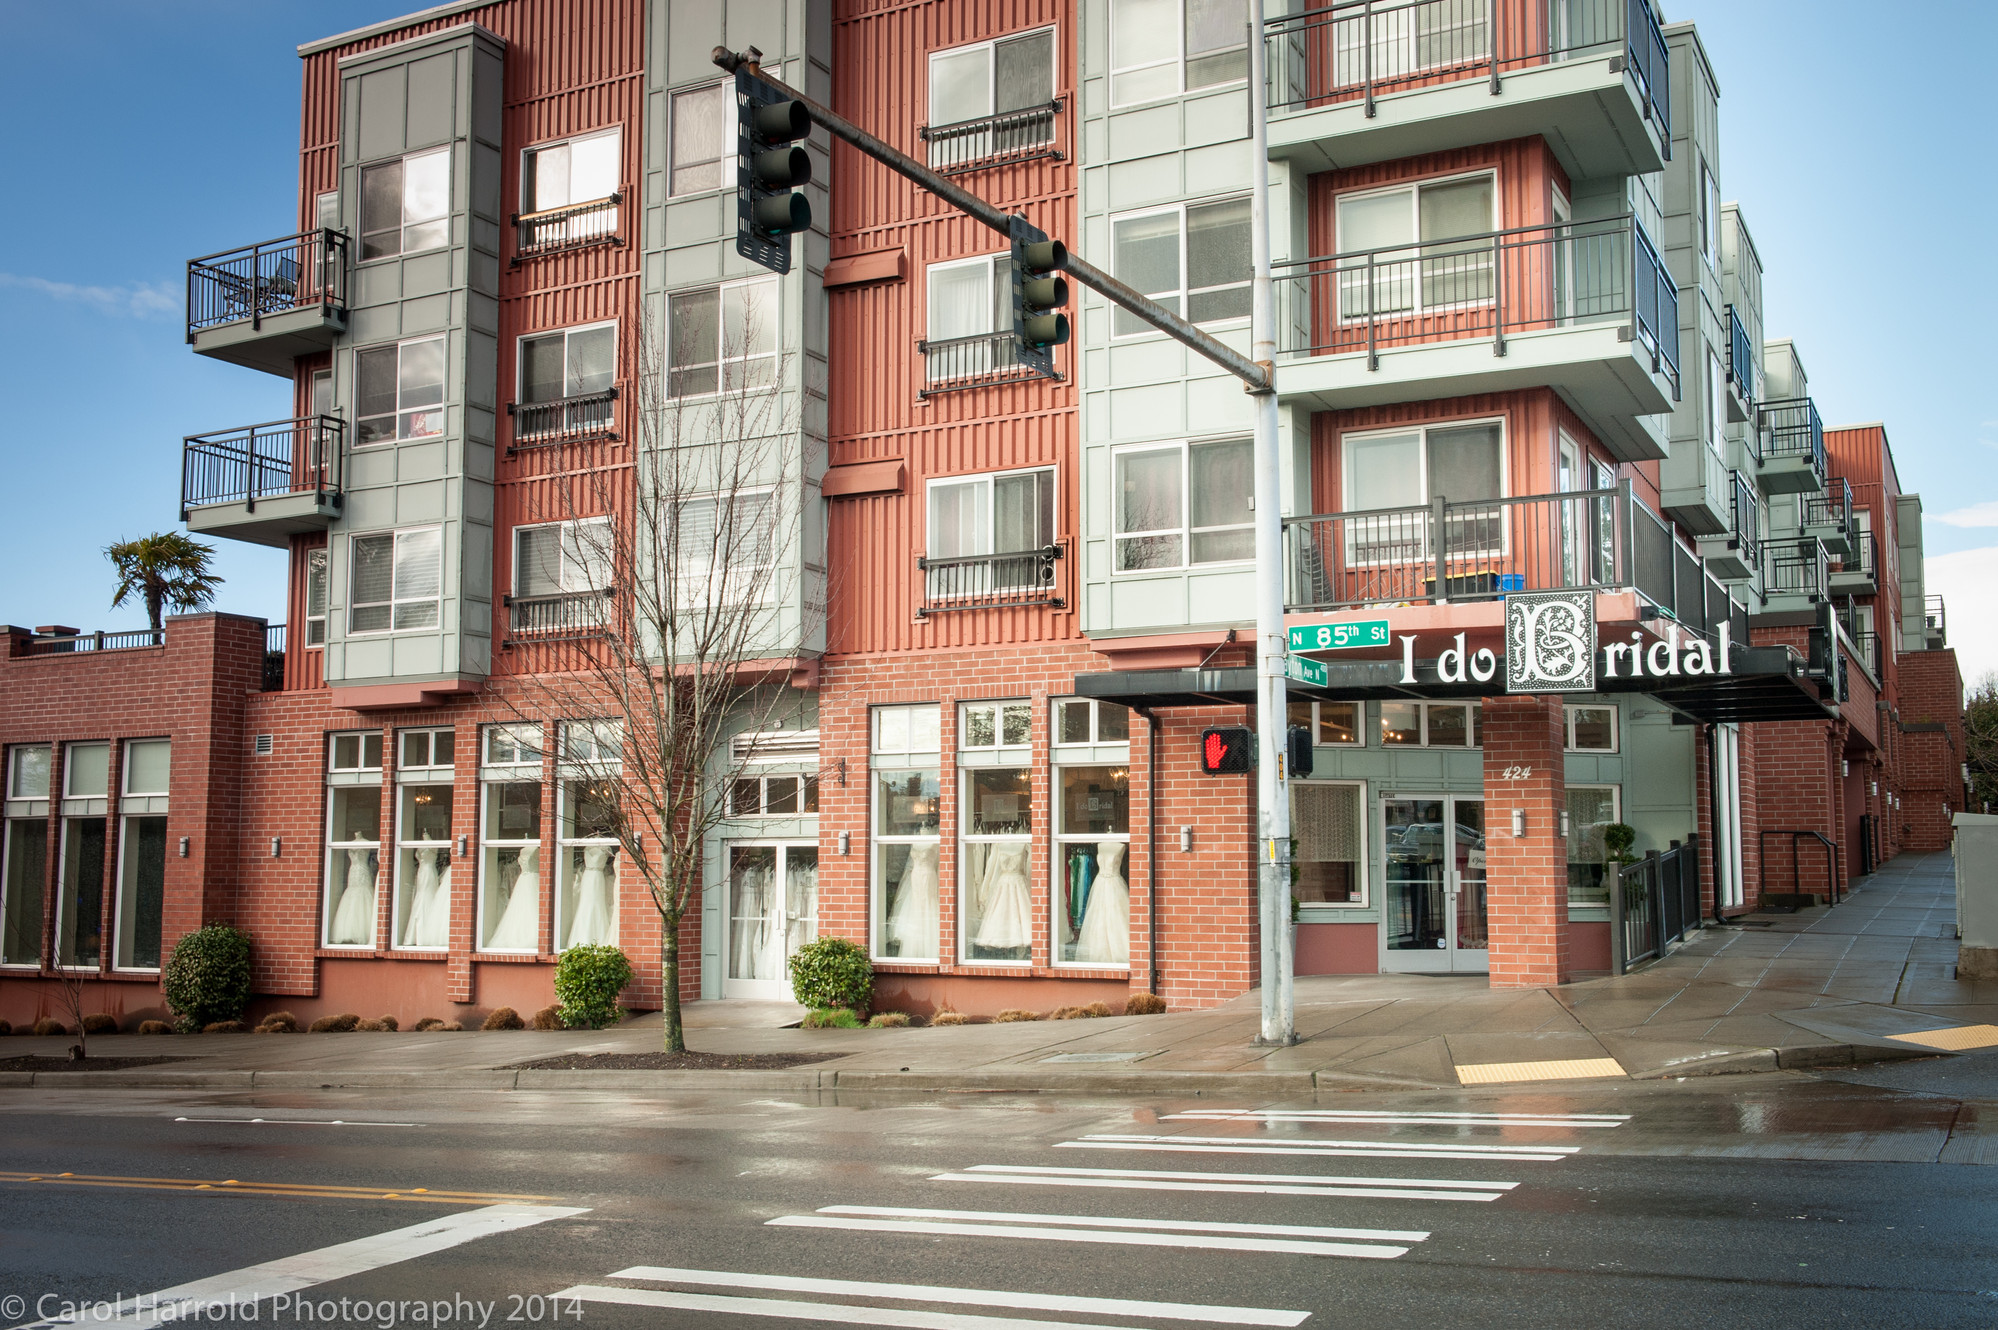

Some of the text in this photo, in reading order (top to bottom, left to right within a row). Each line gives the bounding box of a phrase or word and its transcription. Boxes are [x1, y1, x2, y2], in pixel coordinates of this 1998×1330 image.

[1292, 625, 1386, 647] N 85th St
[1398, 600, 1732, 685] I do Bridal
[1304, 665, 1313, 679] Ave
[1315, 668, 1320, 680] N
[1502, 765, 1532, 780] 424
